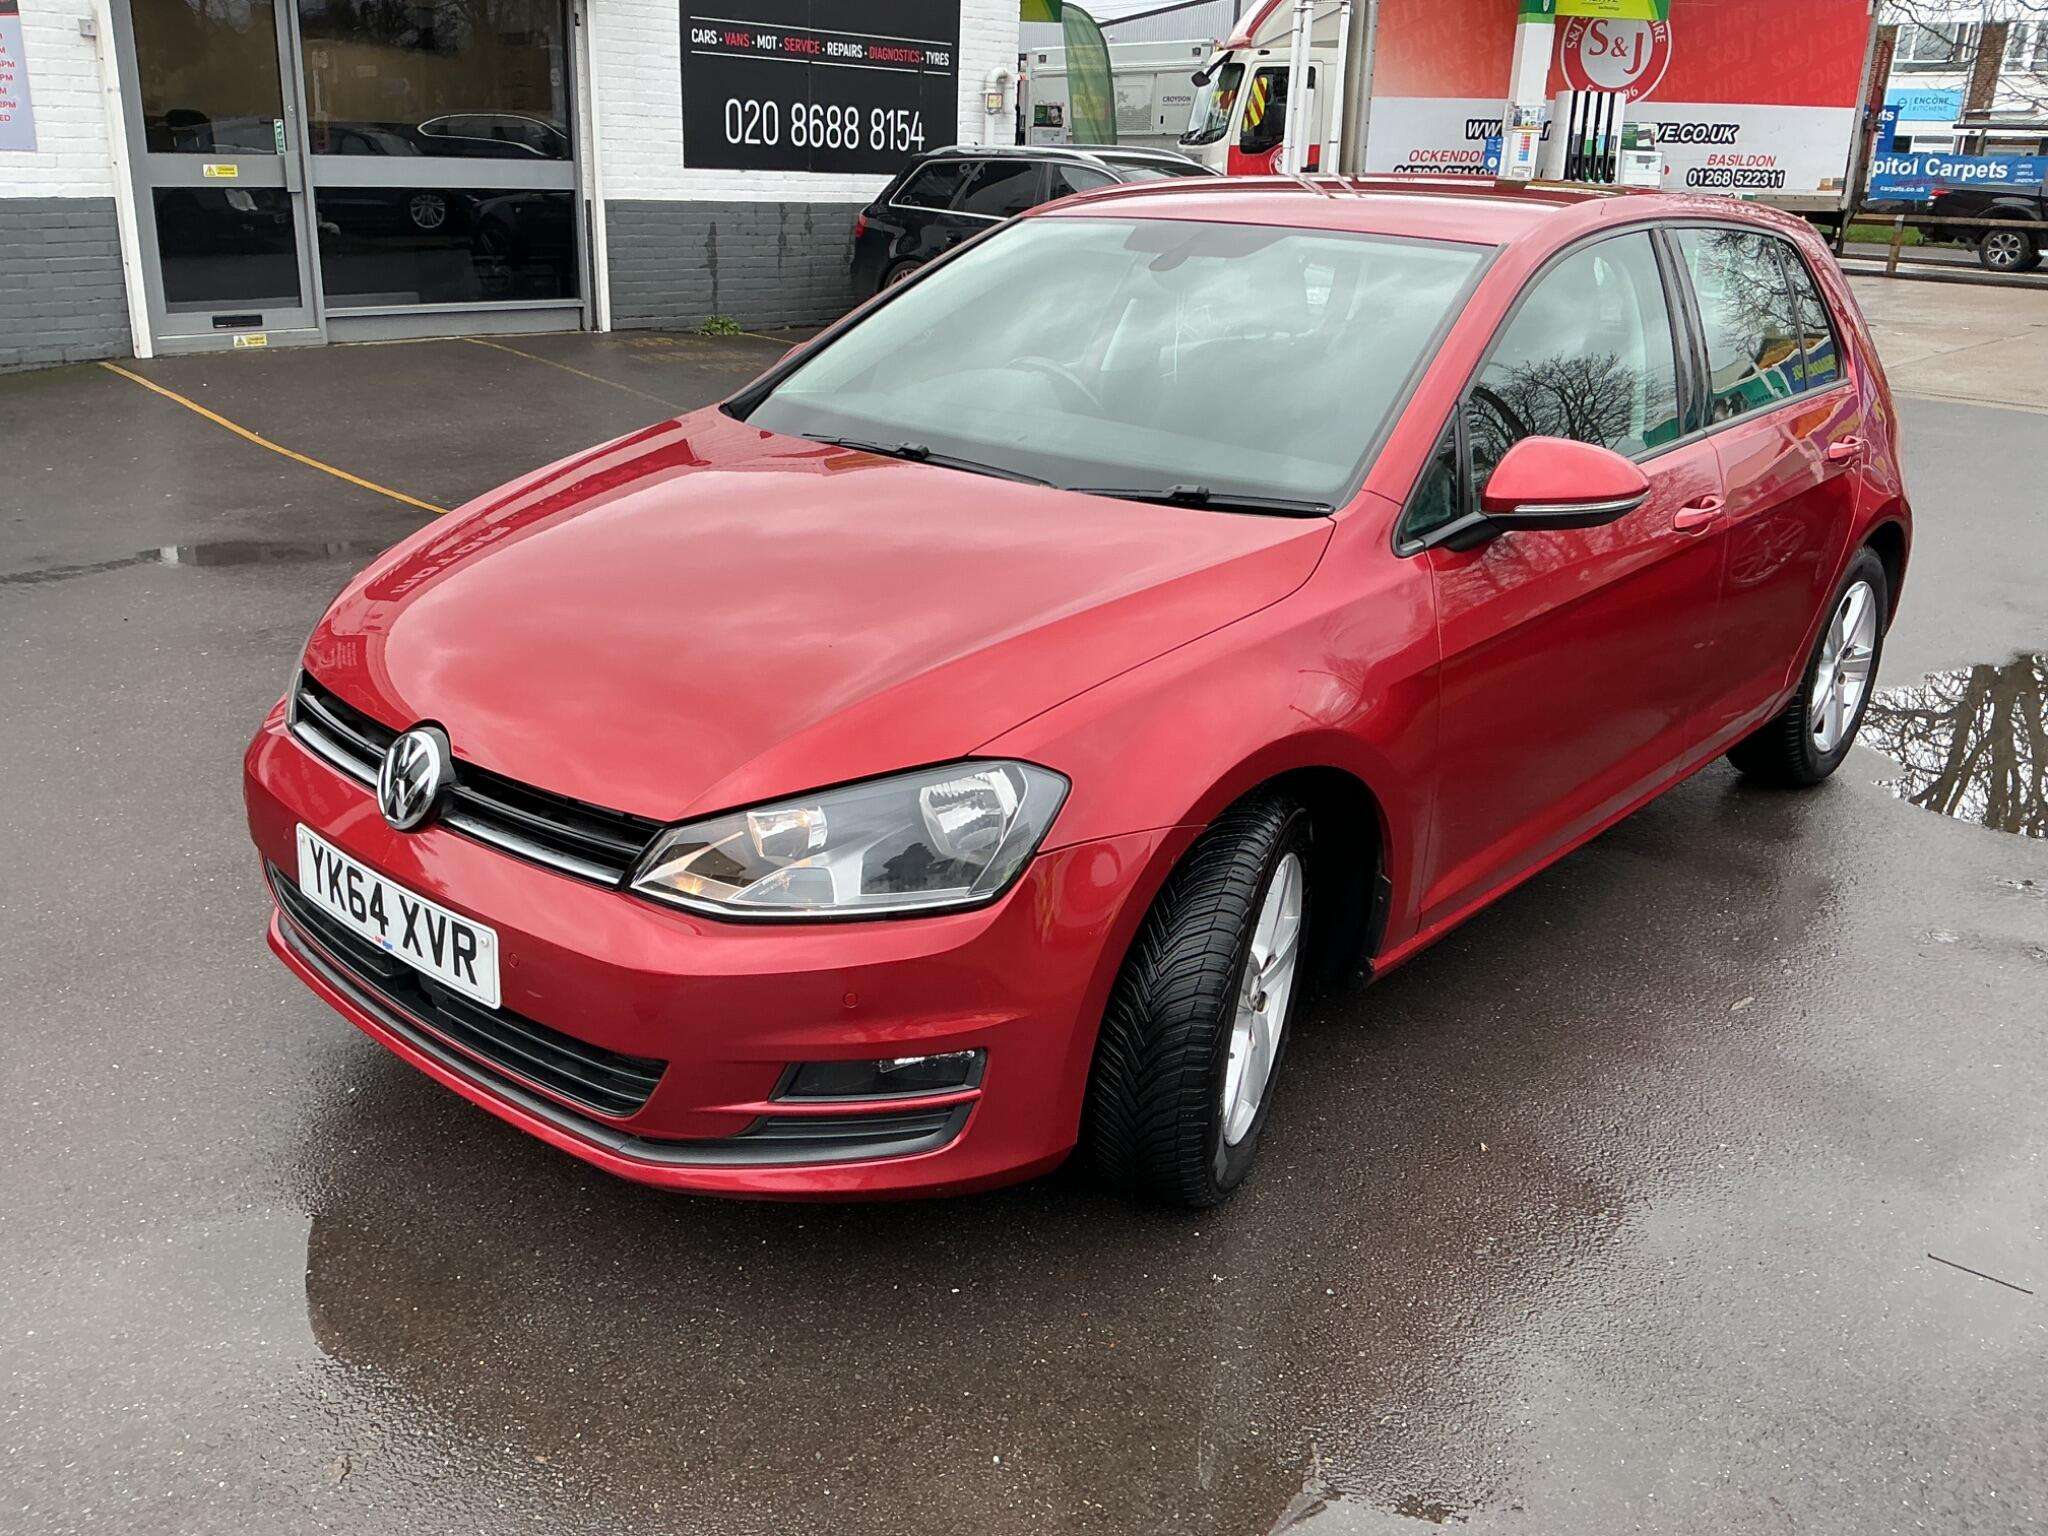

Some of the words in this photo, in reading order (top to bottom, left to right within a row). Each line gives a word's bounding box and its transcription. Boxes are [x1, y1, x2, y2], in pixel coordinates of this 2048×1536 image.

[1651, 19, 1666, 44] IRE
[691, 28, 718, 45] CARS
[724, 32, 750, 48] VANS
[757, 35, 778, 50] MOT
[783, 37, 820, 55] SERVICE
[827, 42, 863, 59] REPAIRS
[868, 46, 920, 63] DIAGNOSTICS
[926, 51, 950, 66] TYRES
[1588, 19, 1644, 75] S&J
[1162, 95, 1191, 103] CROYDON
[725, 98, 779, 146] 020
[790, 102, 860, 149] 8688
[870, 107, 925, 152] 8154
[1707, 153, 1776, 167] BASILDON
[1925, 158, 2008, 182] Carpets
[1687, 169, 1731, 187] 01268
[1734, 170, 1784, 188] 522311
[309, 838, 389, 937] YK64
[399, 894, 478, 987] XVR
